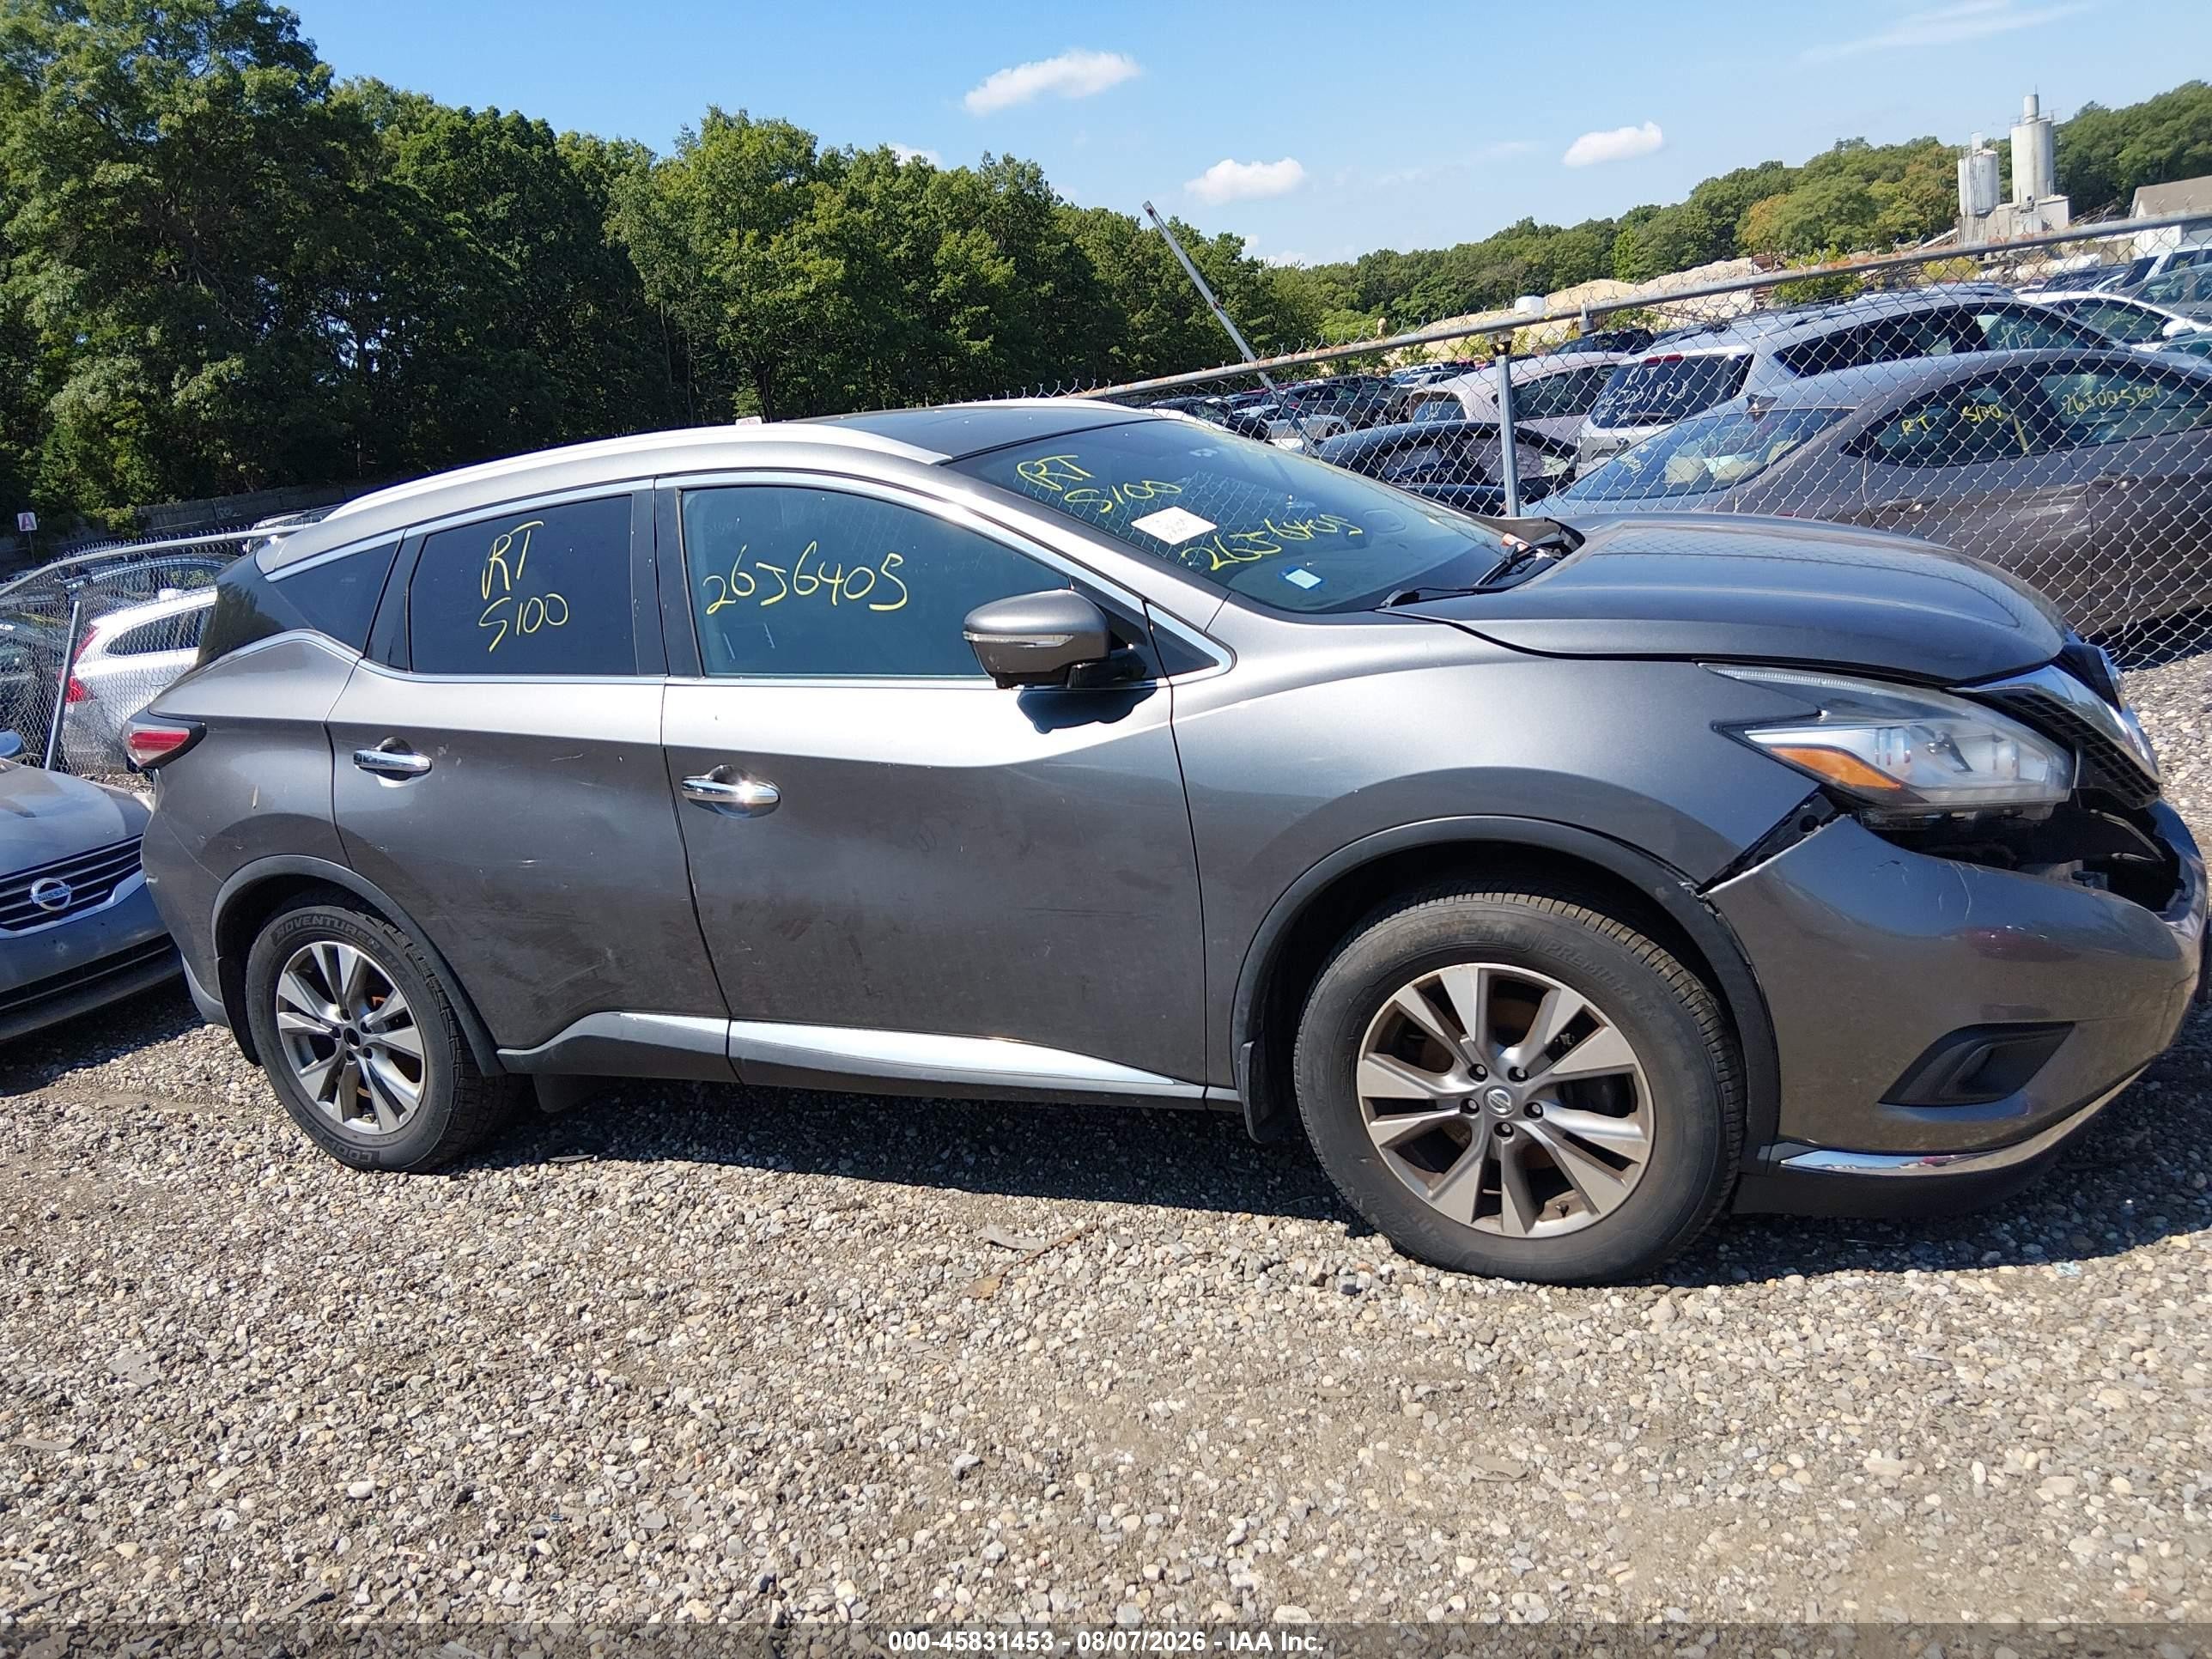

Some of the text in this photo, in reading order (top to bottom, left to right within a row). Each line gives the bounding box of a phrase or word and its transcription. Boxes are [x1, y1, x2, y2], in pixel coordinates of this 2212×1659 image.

[1017, 455, 1095, 491] RT
[1064, 480, 1182, 514] S100
[481, 520, 544, 600] RT
[478, 592, 568, 653] S100
